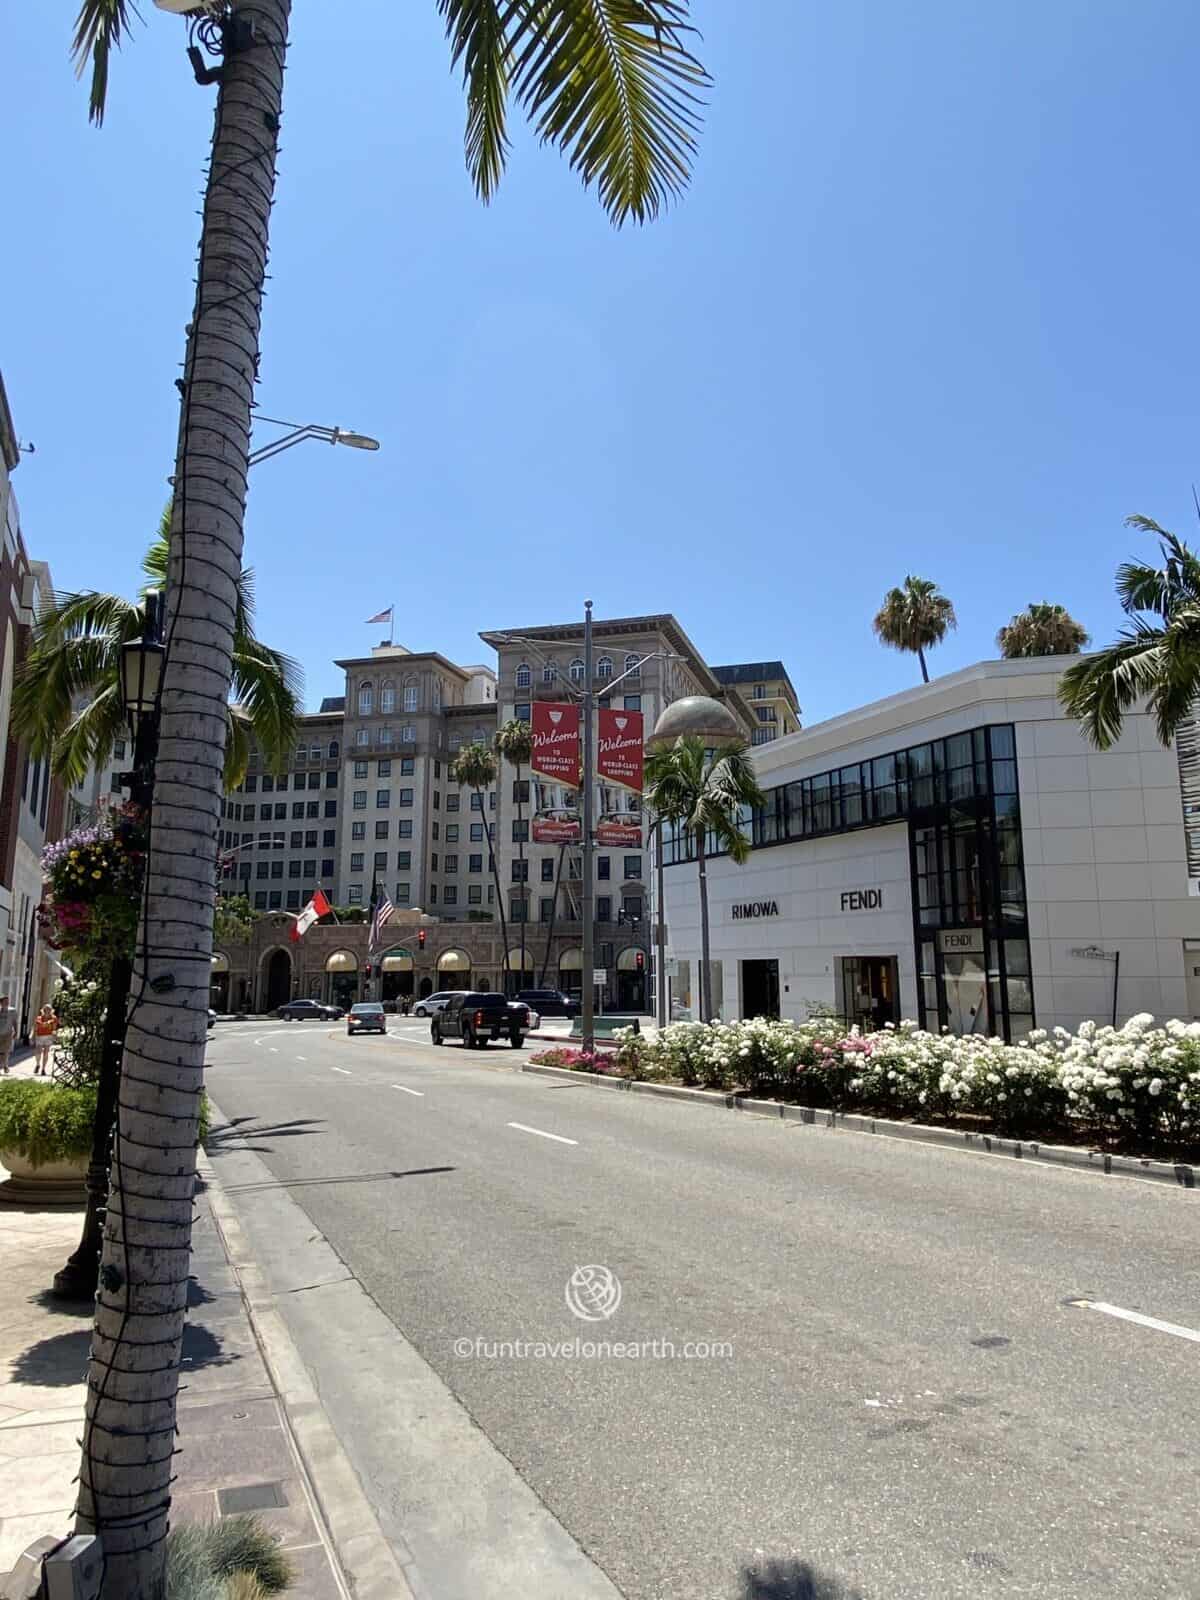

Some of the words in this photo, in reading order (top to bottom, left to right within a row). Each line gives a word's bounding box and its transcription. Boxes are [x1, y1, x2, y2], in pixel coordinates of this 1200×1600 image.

[531, 729, 578, 748] Welcome
[599, 735, 642, 753] Welcome
[840, 889, 883, 911] FENDI
[731, 900, 779, 920] RIMOWA
[944, 934, 973, 946] FENDI
